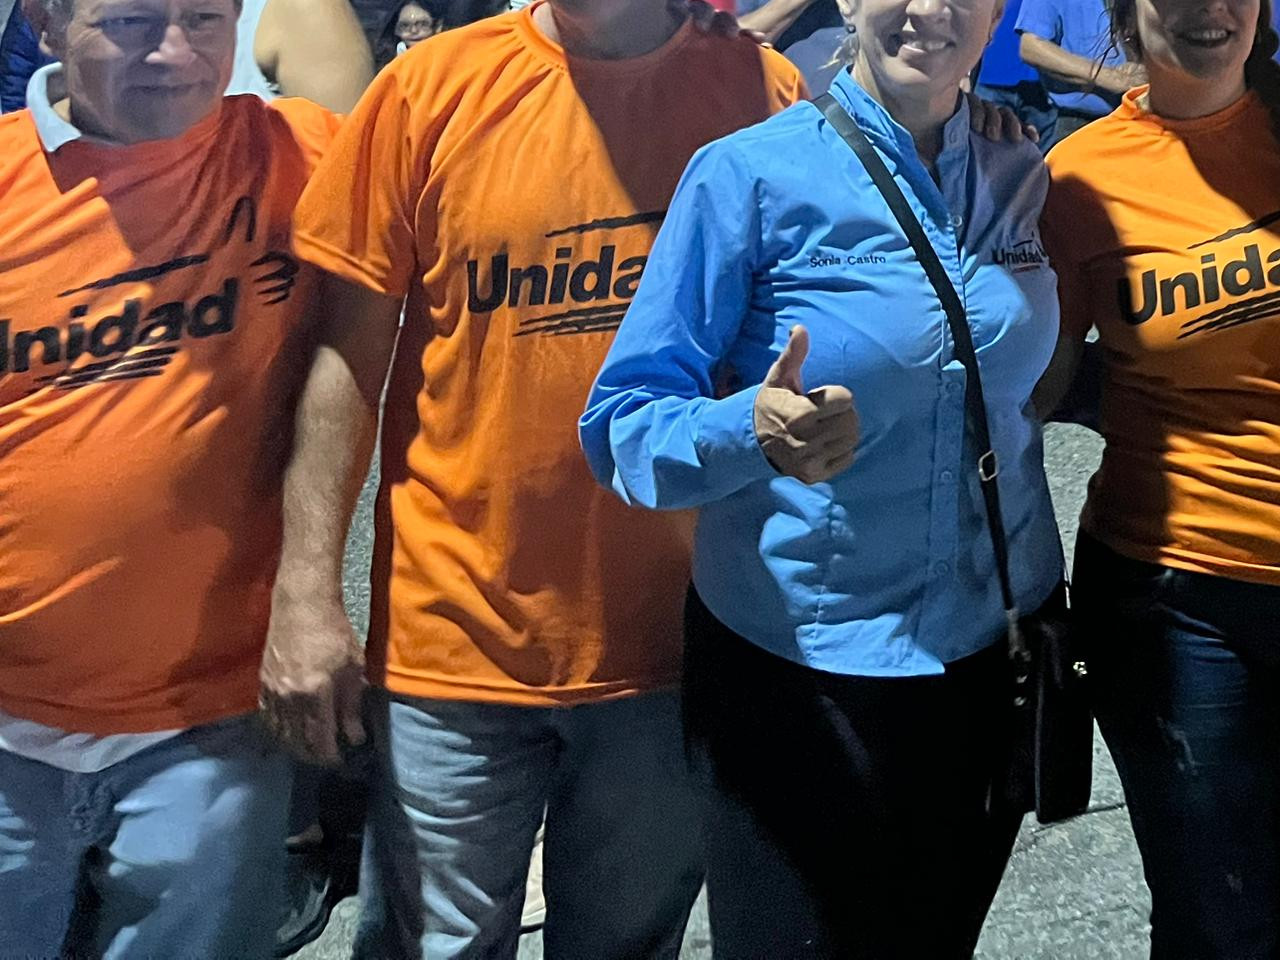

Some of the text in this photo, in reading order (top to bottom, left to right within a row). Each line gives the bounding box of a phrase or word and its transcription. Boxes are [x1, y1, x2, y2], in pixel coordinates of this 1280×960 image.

[467, 244, 650, 314] Unida
[847, 254, 887, 266] Castro
[0, 277, 239, 374] nidad
